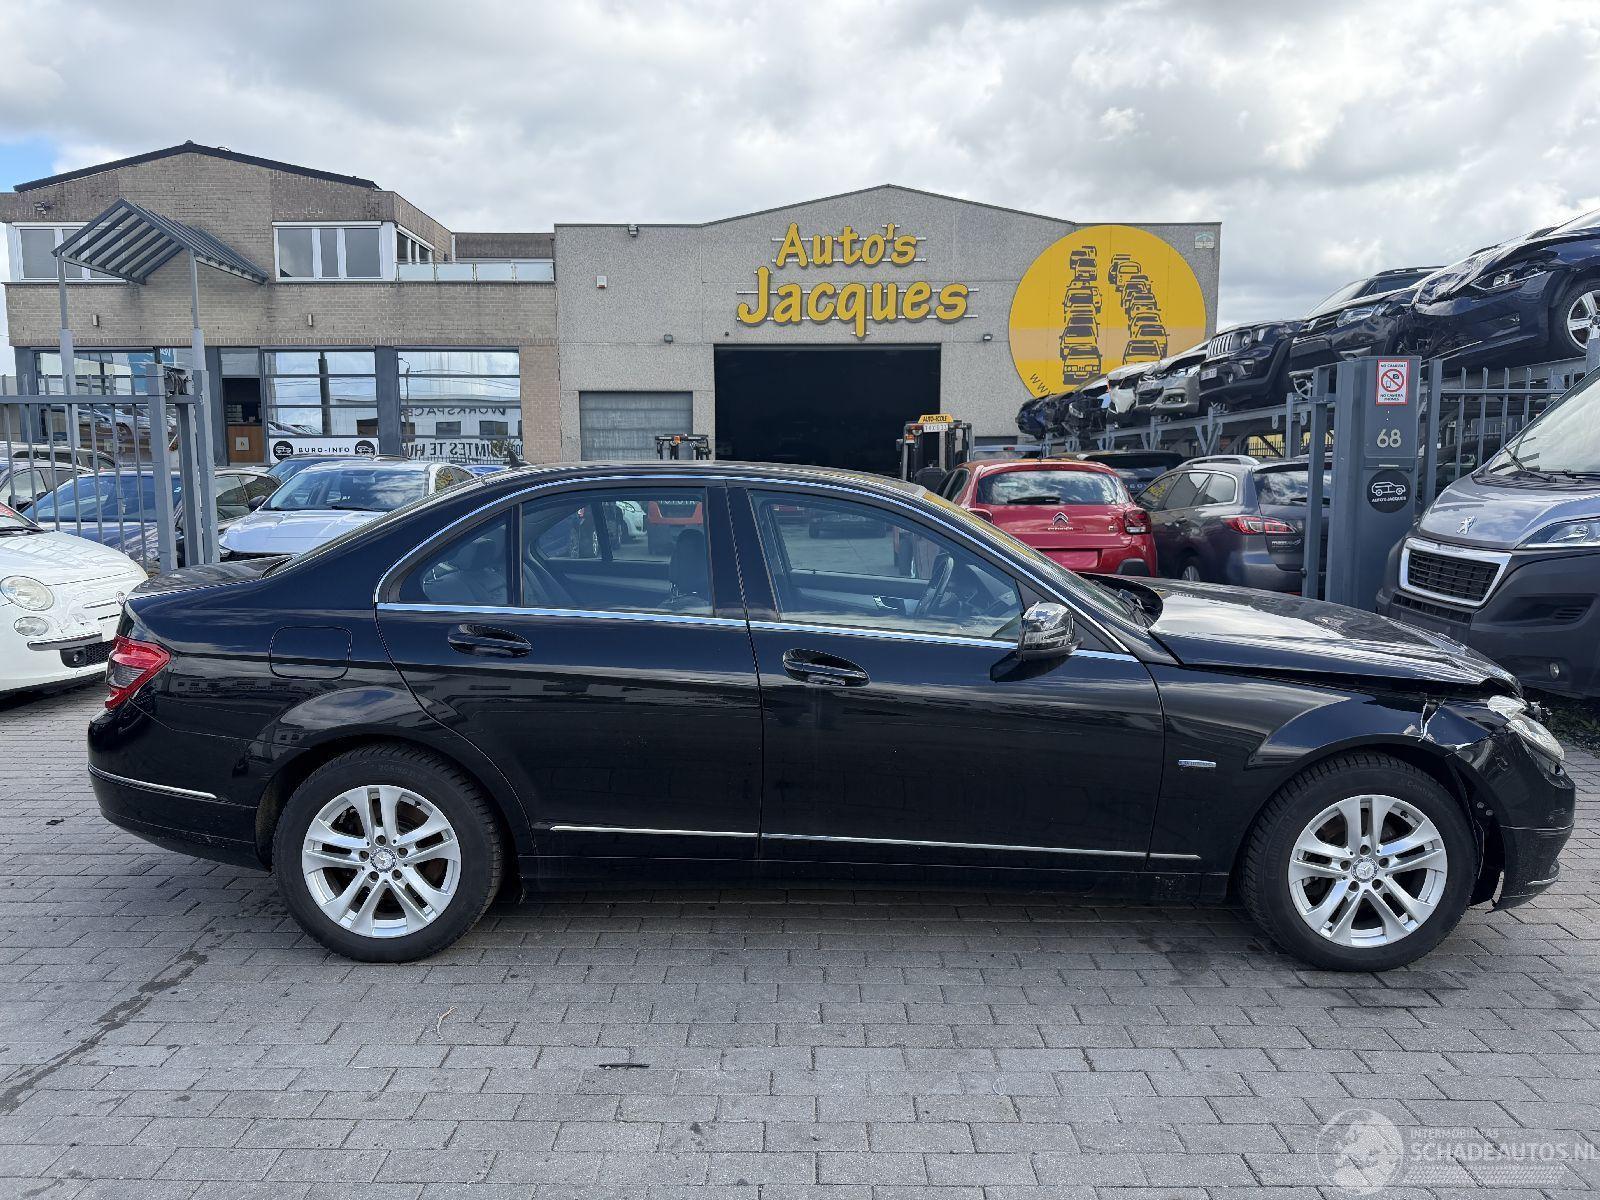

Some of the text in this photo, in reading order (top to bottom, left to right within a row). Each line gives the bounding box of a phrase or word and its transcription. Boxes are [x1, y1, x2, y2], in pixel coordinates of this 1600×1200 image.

[775, 222, 917, 268] Auto's
[736, 266, 969, 339] Jacques
[1376, 428, 1402, 448] 68
